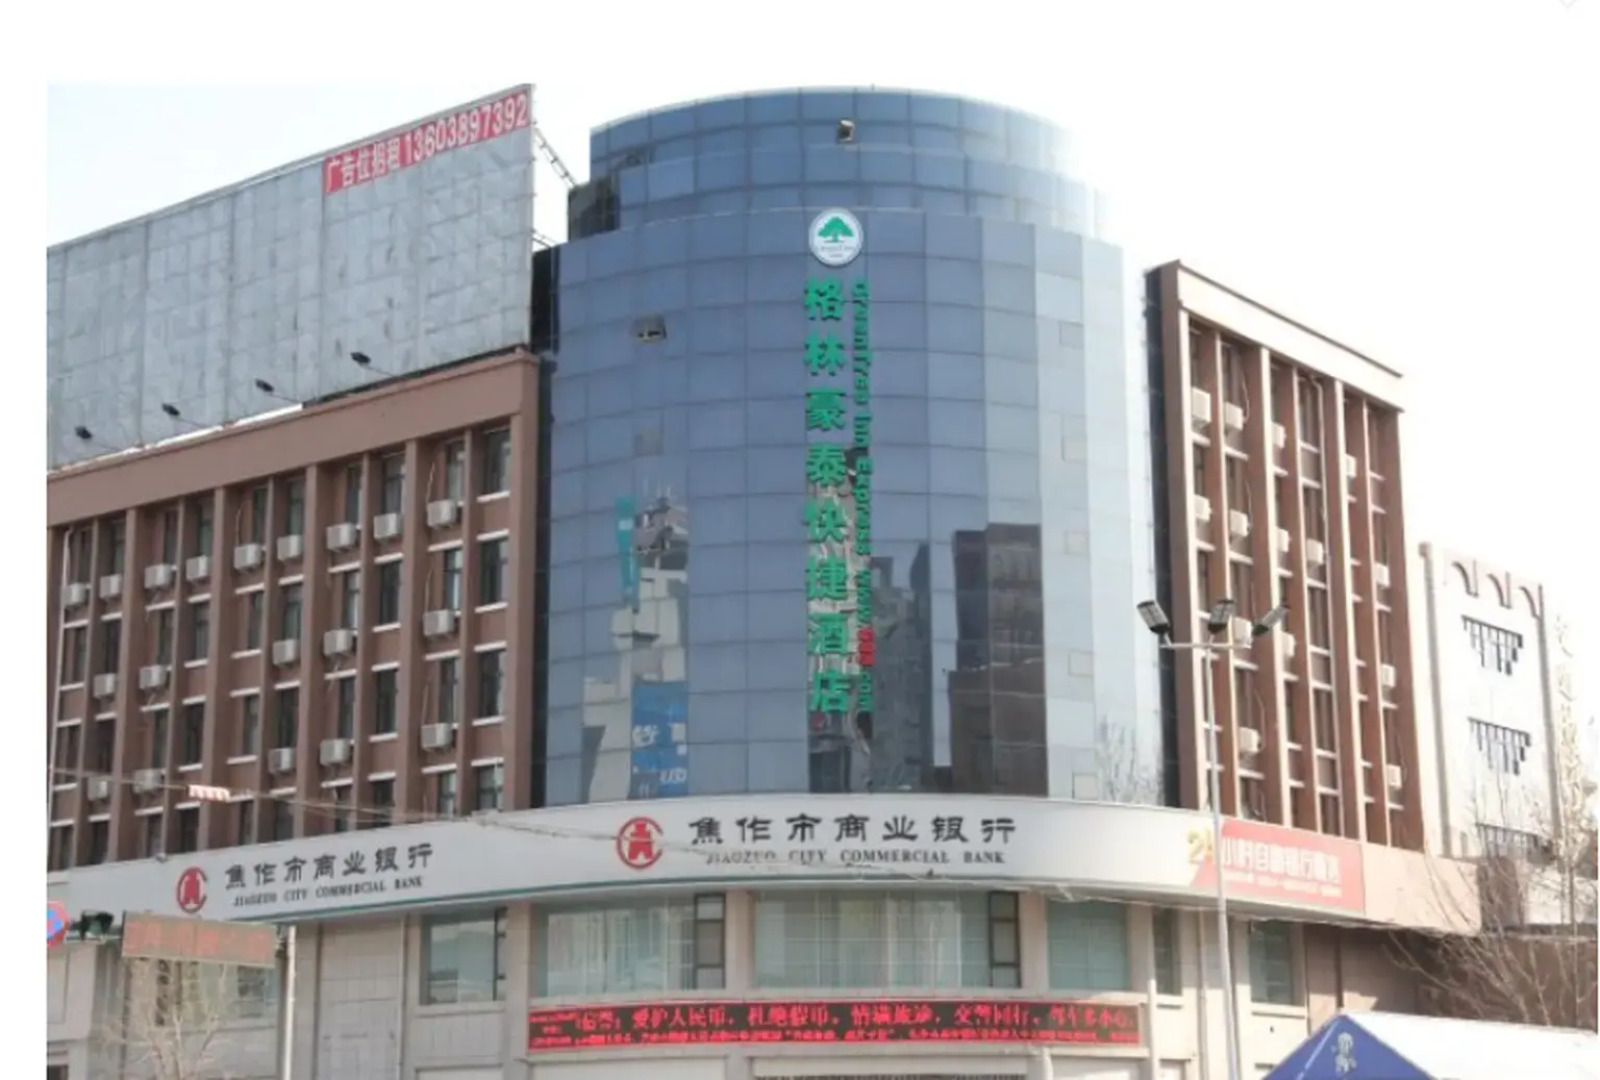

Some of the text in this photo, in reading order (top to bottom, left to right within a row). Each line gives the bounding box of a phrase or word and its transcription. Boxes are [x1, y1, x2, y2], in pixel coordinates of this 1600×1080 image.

[803, 275, 848, 714] 格林豪泰快捷酒店
[688, 813, 1017, 845] 焦作市商业银行
[225, 842, 433, 890] 焦作市商业银行
[788, 848, 827, 865] CITY
[840, 848, 950, 864] COMMERCIAL
[963, 850, 1006, 864] BANK
[394, 875, 423, 890] BANK
